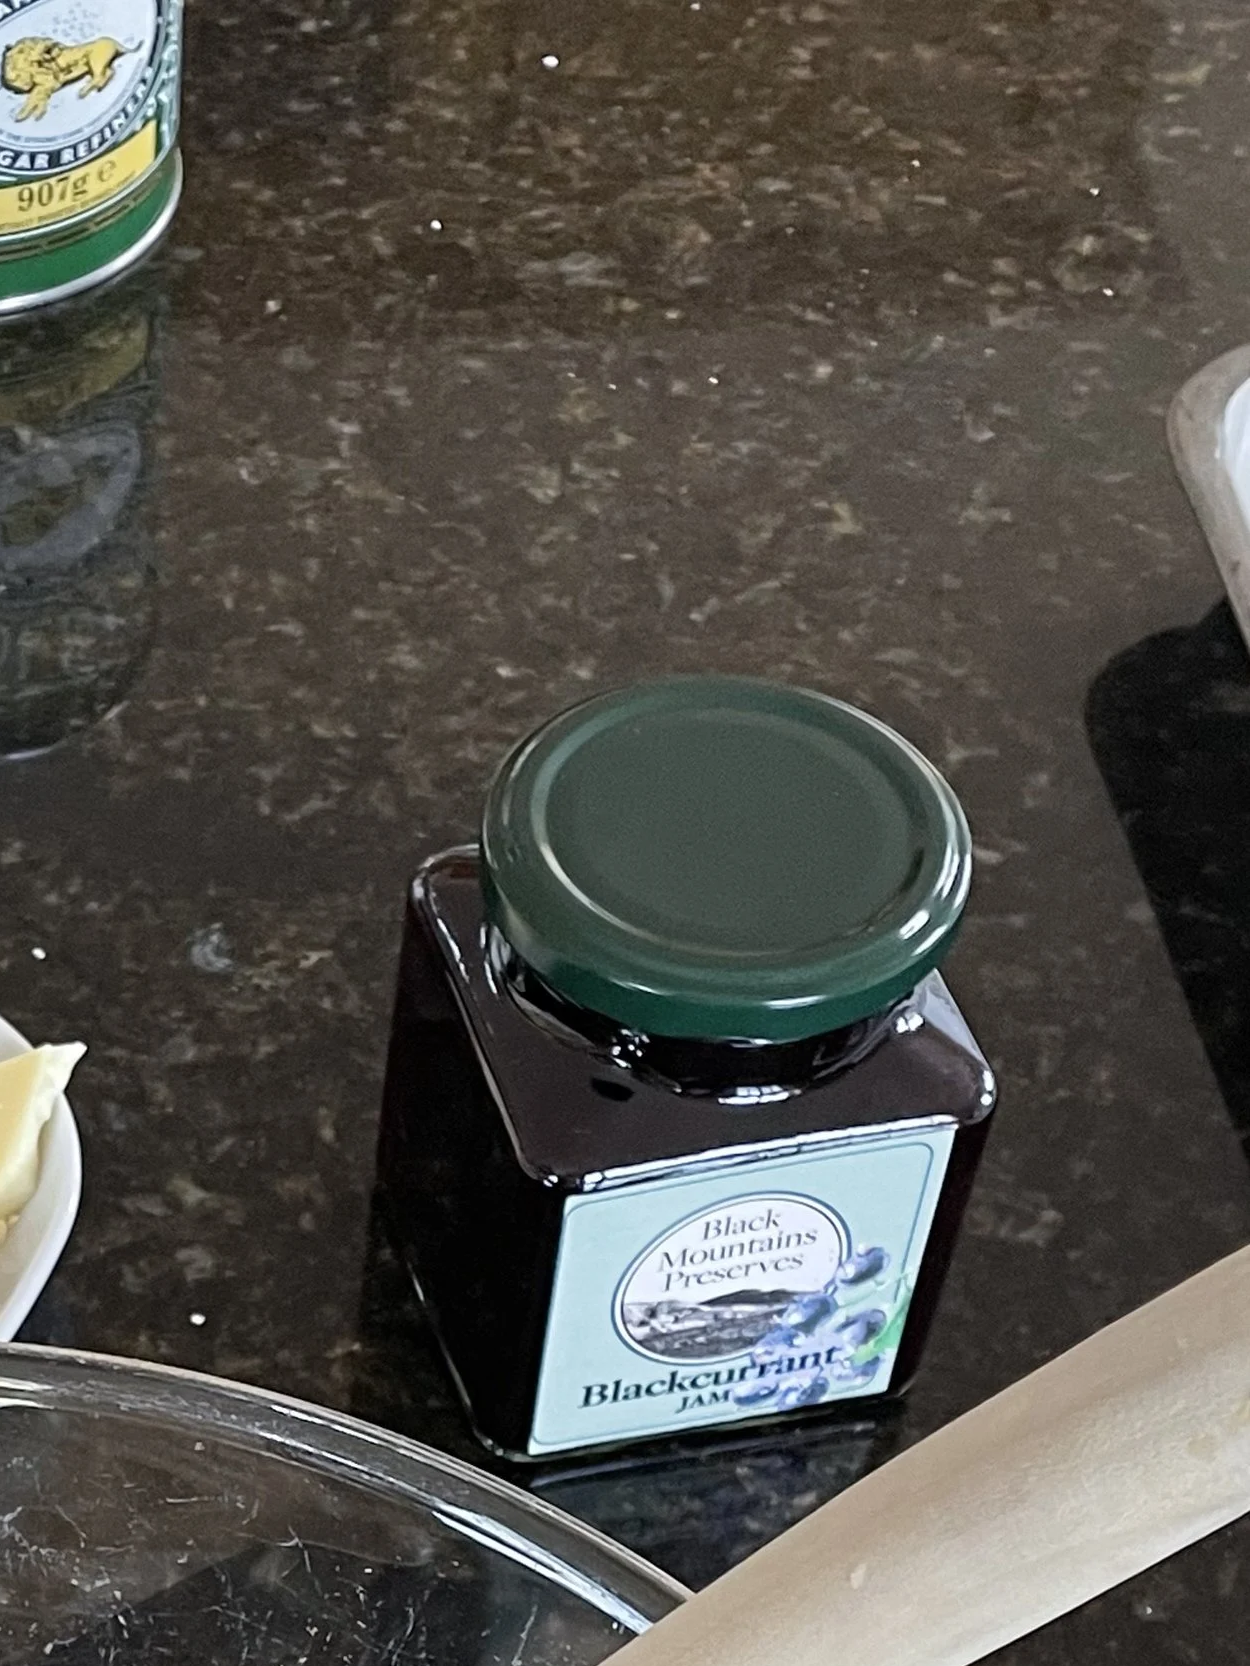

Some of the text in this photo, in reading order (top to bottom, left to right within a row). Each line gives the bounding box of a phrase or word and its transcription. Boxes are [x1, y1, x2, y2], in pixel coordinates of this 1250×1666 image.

[16, 172, 91, 213] 907g
[702, 1208, 782, 1241] Black
[657, 1228, 819, 1273] Mountains
[662, 1252, 805, 1293] Preserves
[577, 1345, 844, 1410] Blackcurrant
[674, 1389, 731, 1414] JAM
